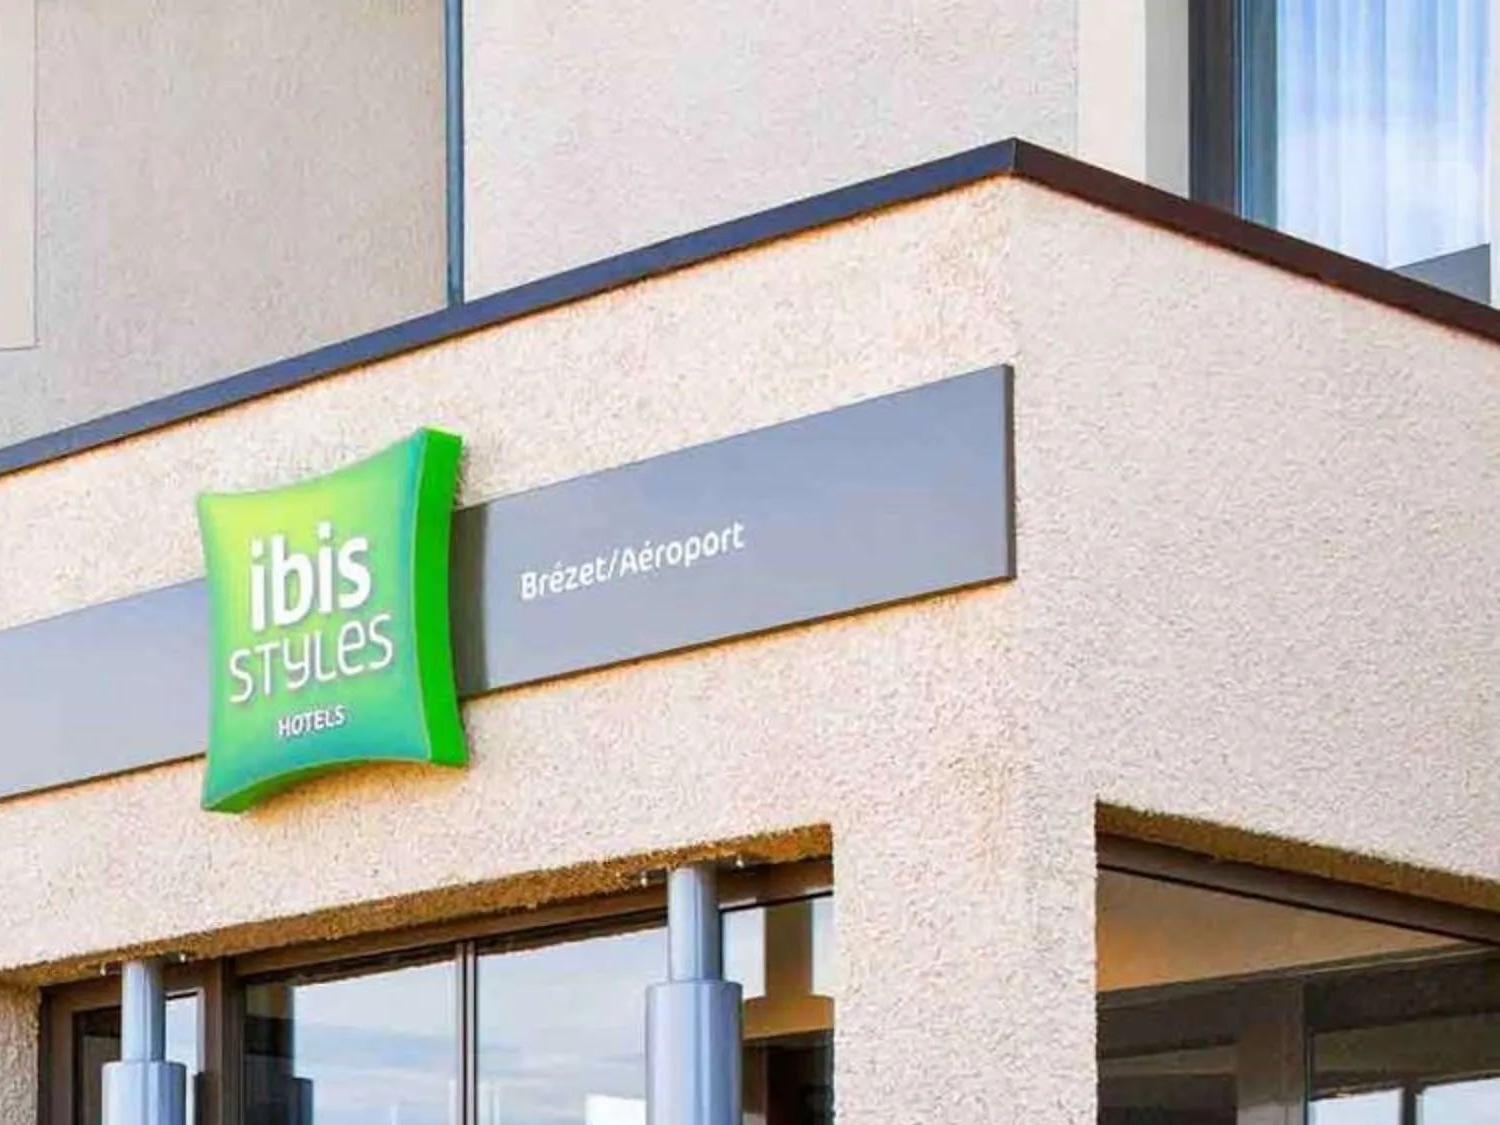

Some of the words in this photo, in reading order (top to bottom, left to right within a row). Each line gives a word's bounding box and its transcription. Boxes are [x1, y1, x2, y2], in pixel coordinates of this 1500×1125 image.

[250, 520, 372, 632] ibis
[519, 520, 746, 601] Brézet/Aéroport
[277, 704, 346, 737] HOTELS
